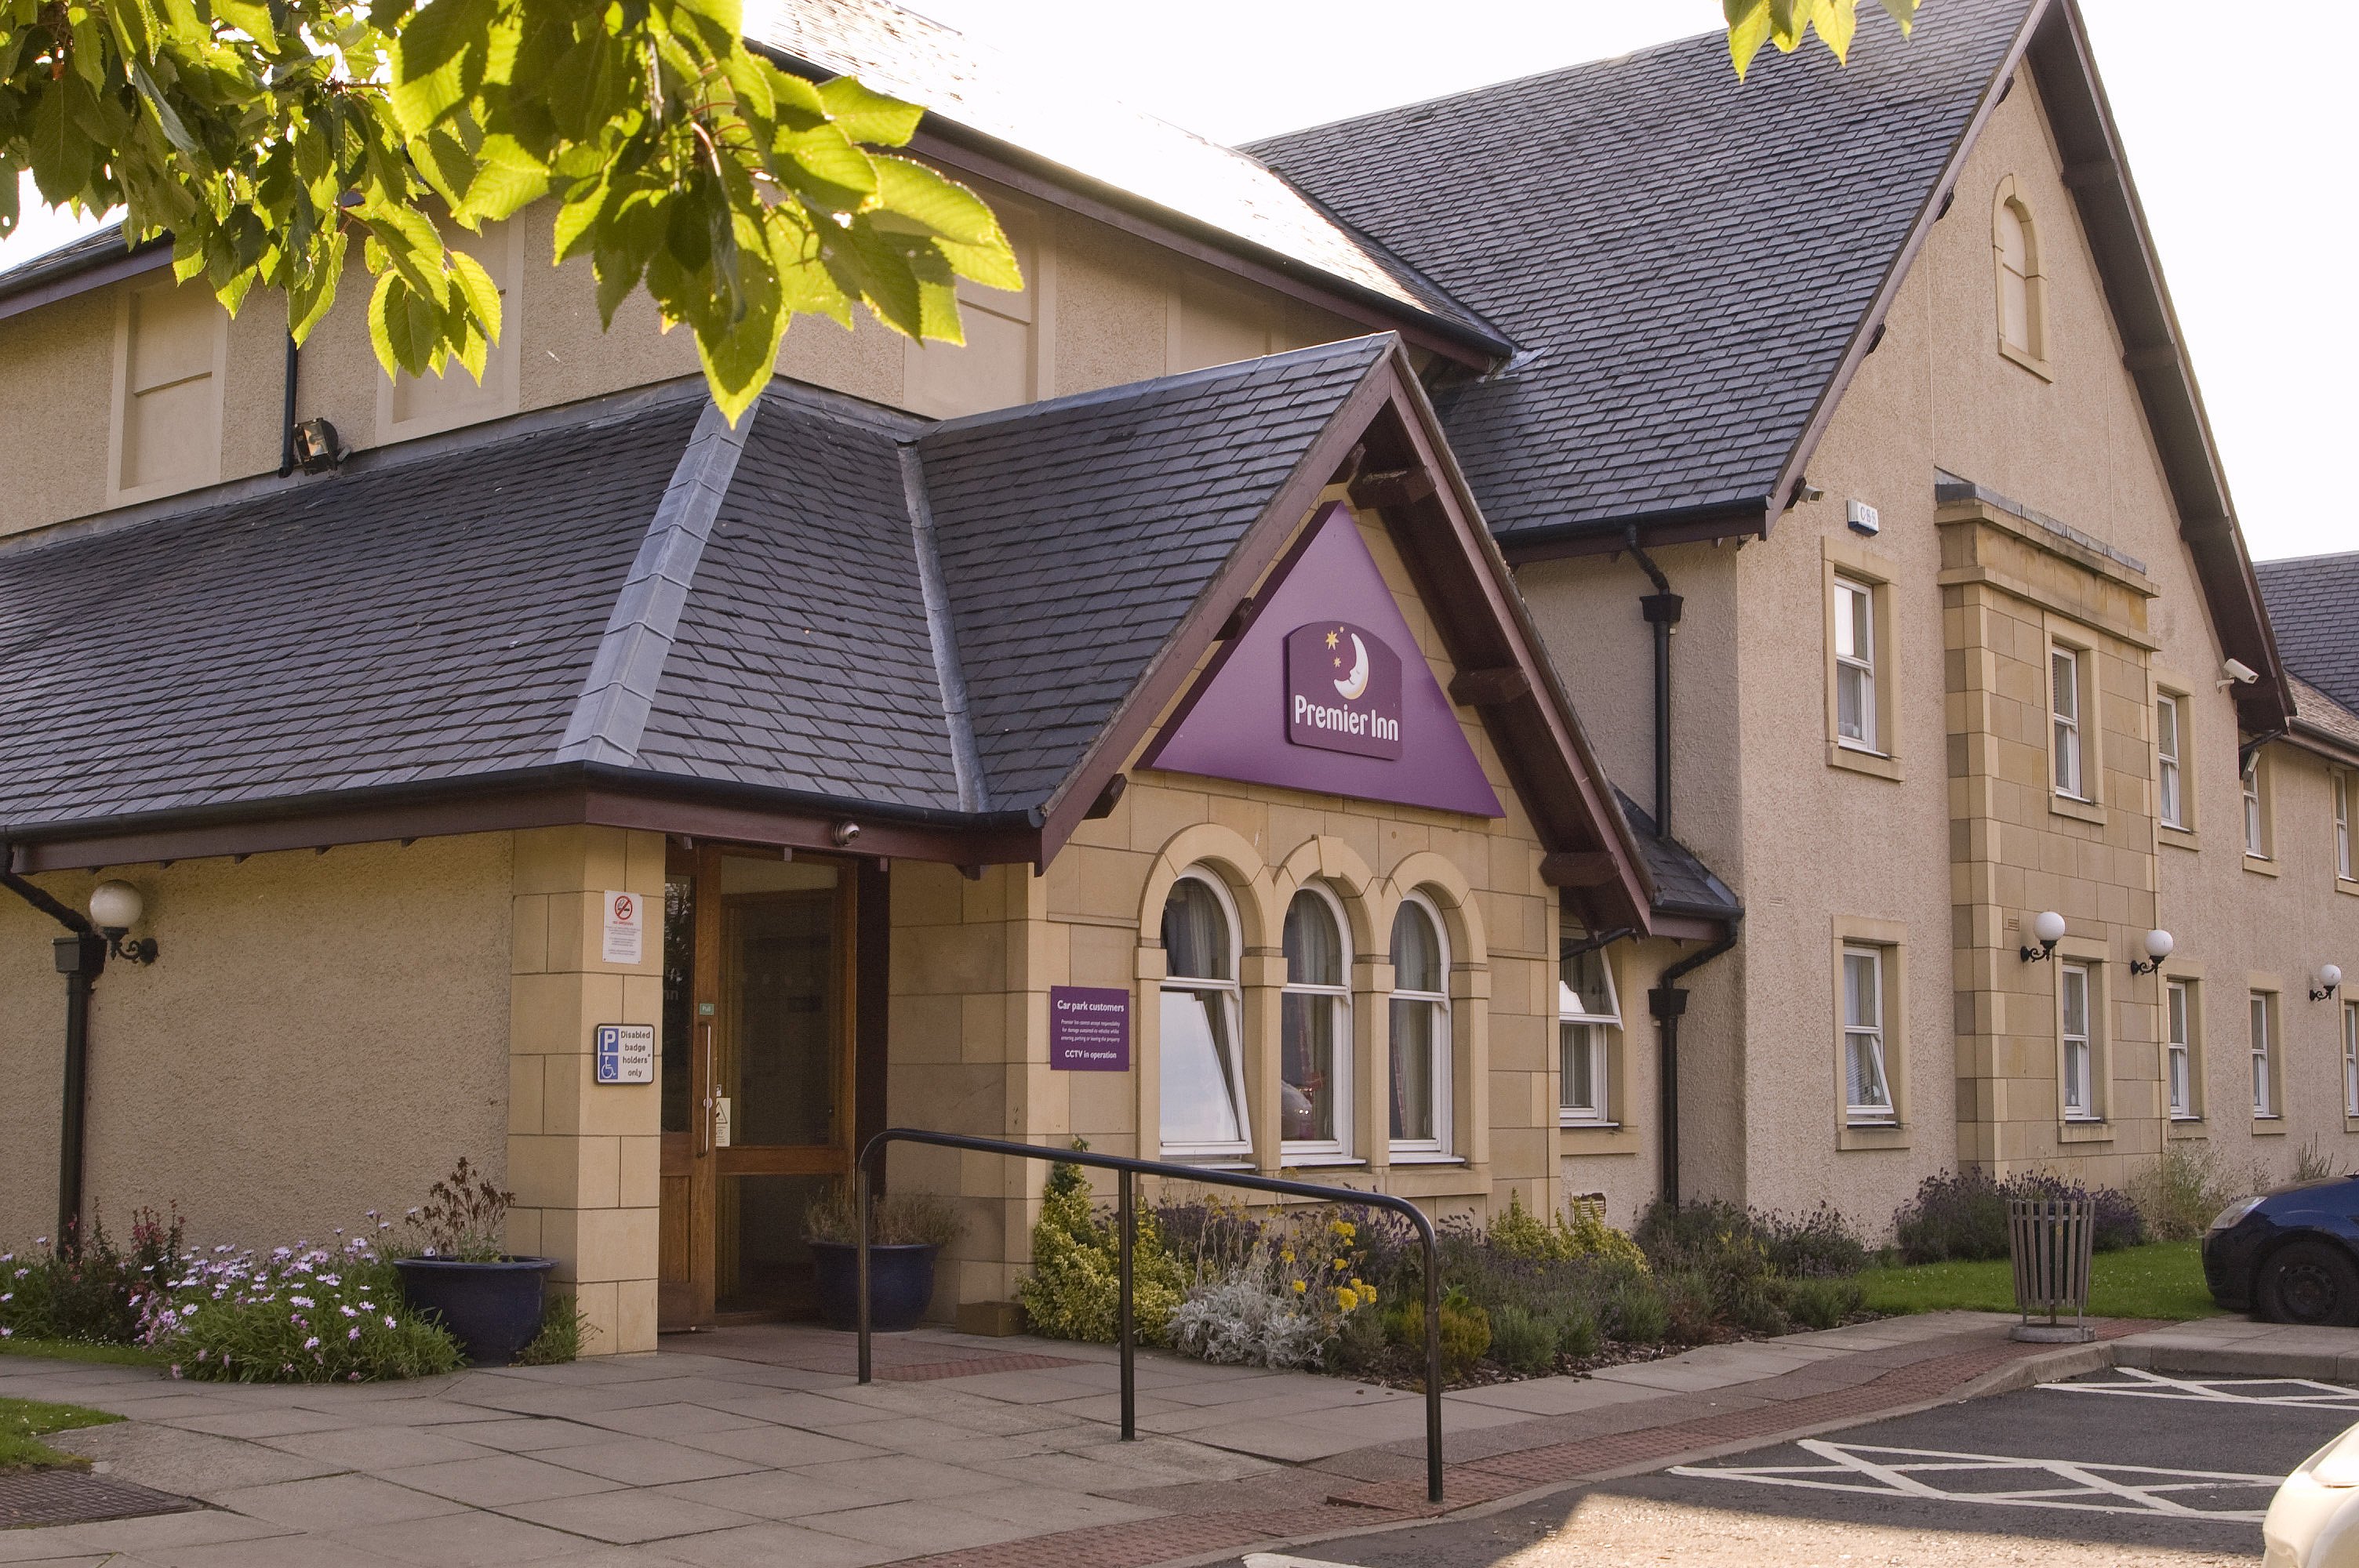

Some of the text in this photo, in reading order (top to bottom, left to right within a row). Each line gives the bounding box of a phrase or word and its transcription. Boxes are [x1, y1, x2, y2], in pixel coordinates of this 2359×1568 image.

[1295, 695, 1399, 742] Premier Inn
[1057, 1000, 1125, 1013] Car park customers
[604, 1030, 616, 1051] P
[624, 1044, 646, 1053] badge
[1065, 1049, 1083, 1058] CCTV
[1089, 1051, 1117, 1060] operation
[627, 1069, 642, 1078] only
